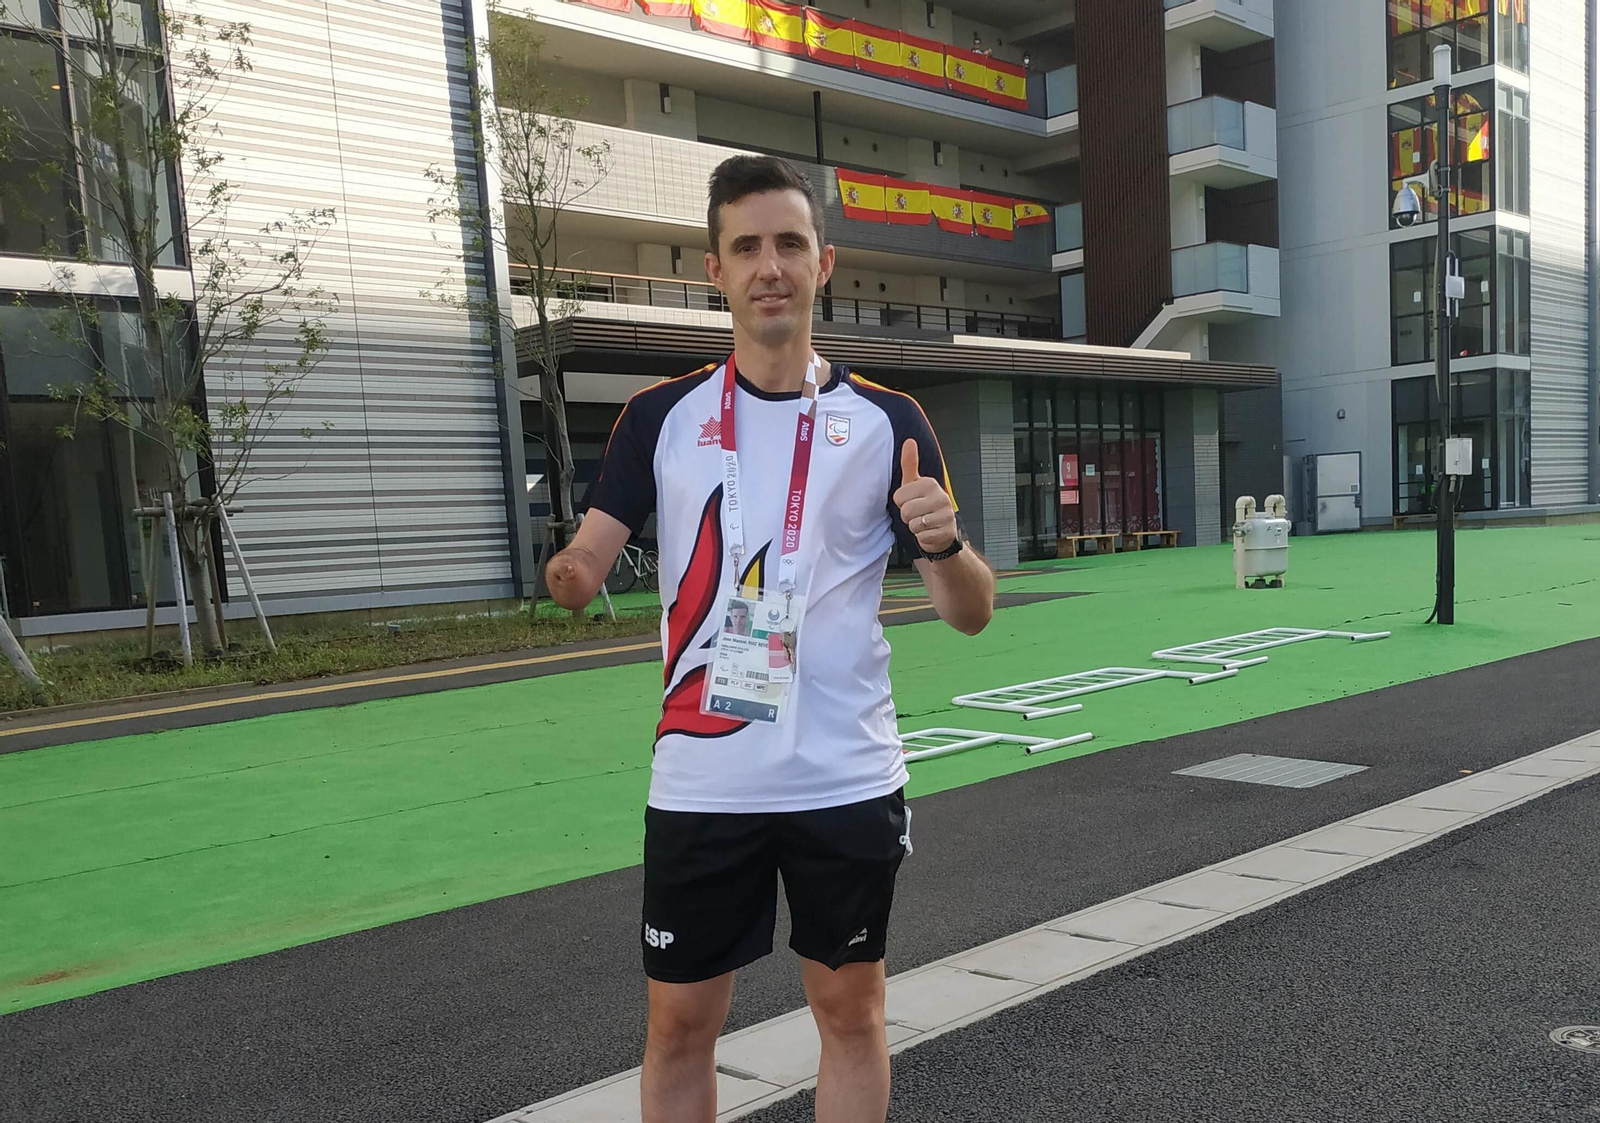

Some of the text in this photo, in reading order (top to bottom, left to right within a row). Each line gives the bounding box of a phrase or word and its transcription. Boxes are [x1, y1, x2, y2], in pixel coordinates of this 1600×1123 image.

[725, 455, 738, 513] TOKYO 2020
[785, 489, 802, 548] TOKYO 2020
[713, 700, 775, 718] A 2 R
